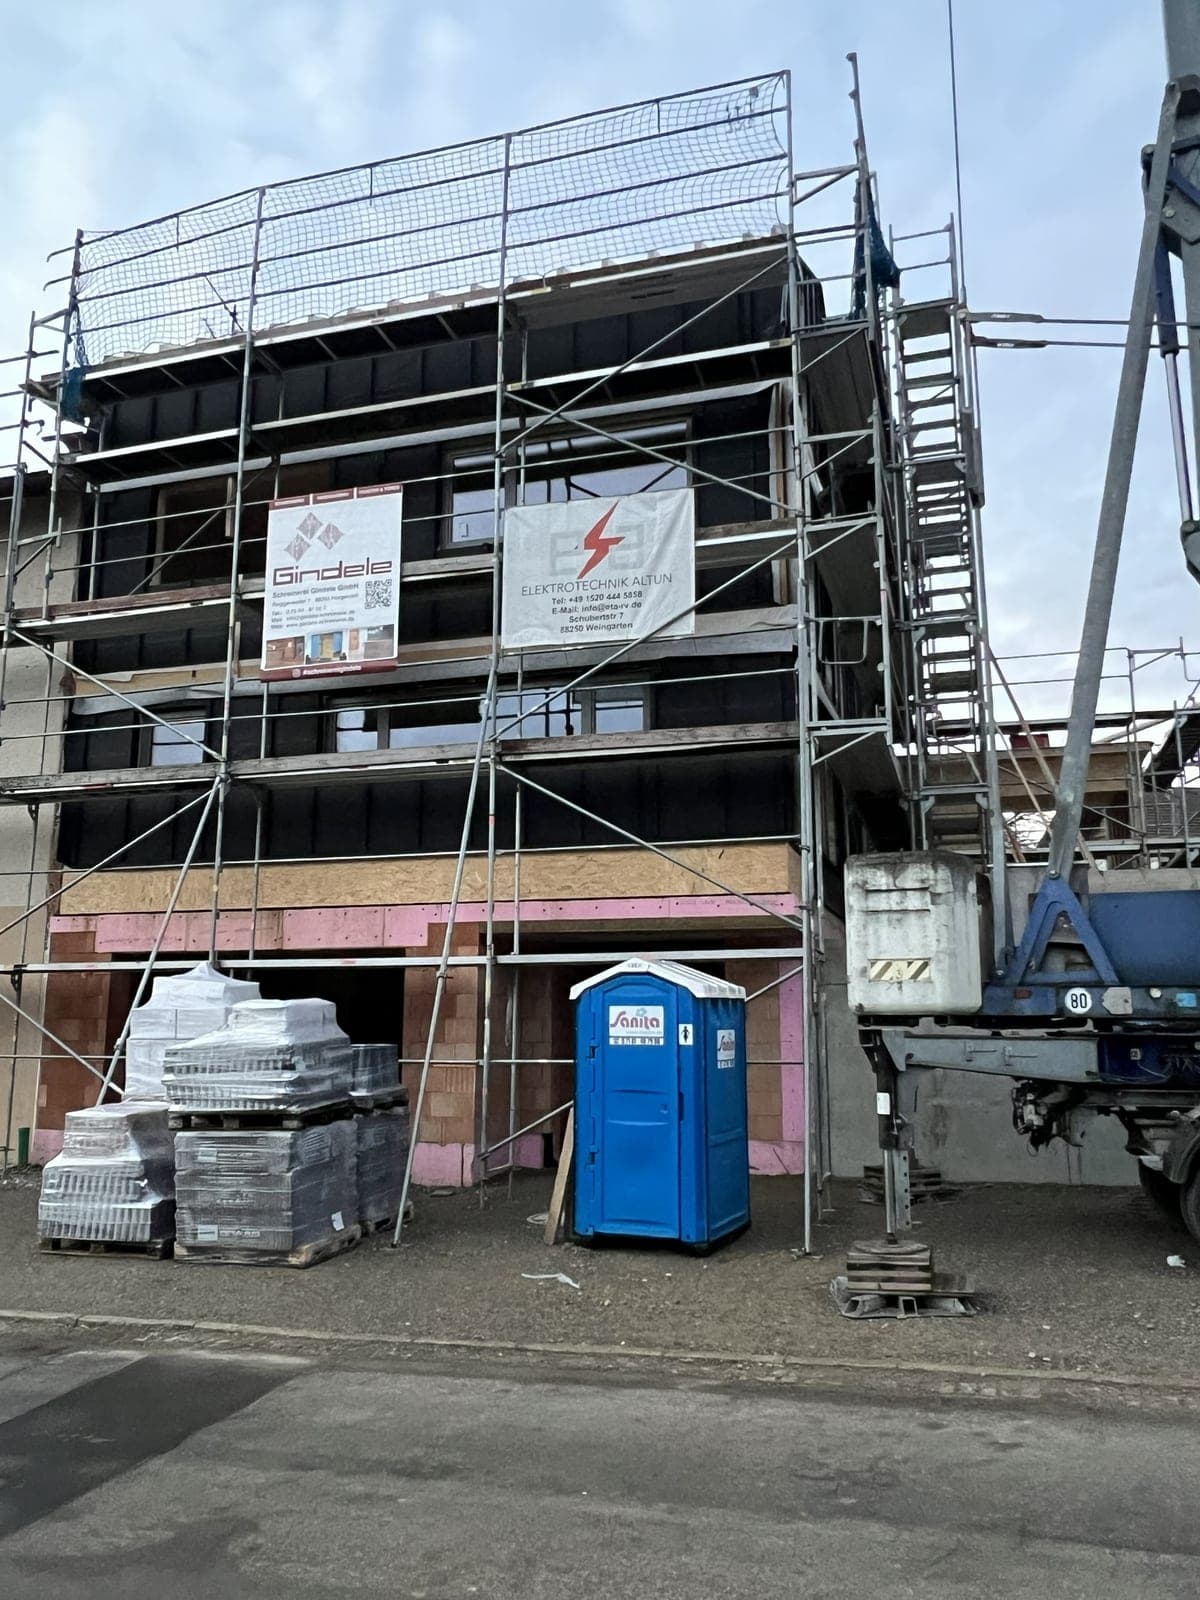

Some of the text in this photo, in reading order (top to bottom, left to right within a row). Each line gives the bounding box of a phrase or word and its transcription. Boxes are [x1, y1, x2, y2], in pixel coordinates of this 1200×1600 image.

[273, 557, 393, 586] Gindele
[521, 573, 673, 596] ELEKTROTECHNIK ALTUN
[552, 597, 566, 605] Tel:
[568, 595, 583, 603] +49
[606, 592, 621, 600] 444
[552, 606, 580, 615] E-Mail:
[560, 622, 633, 634] 88250 Weingarten
[1070, 993, 1088, 1009] 80
[610, 1011, 660, 1030] Sanita
